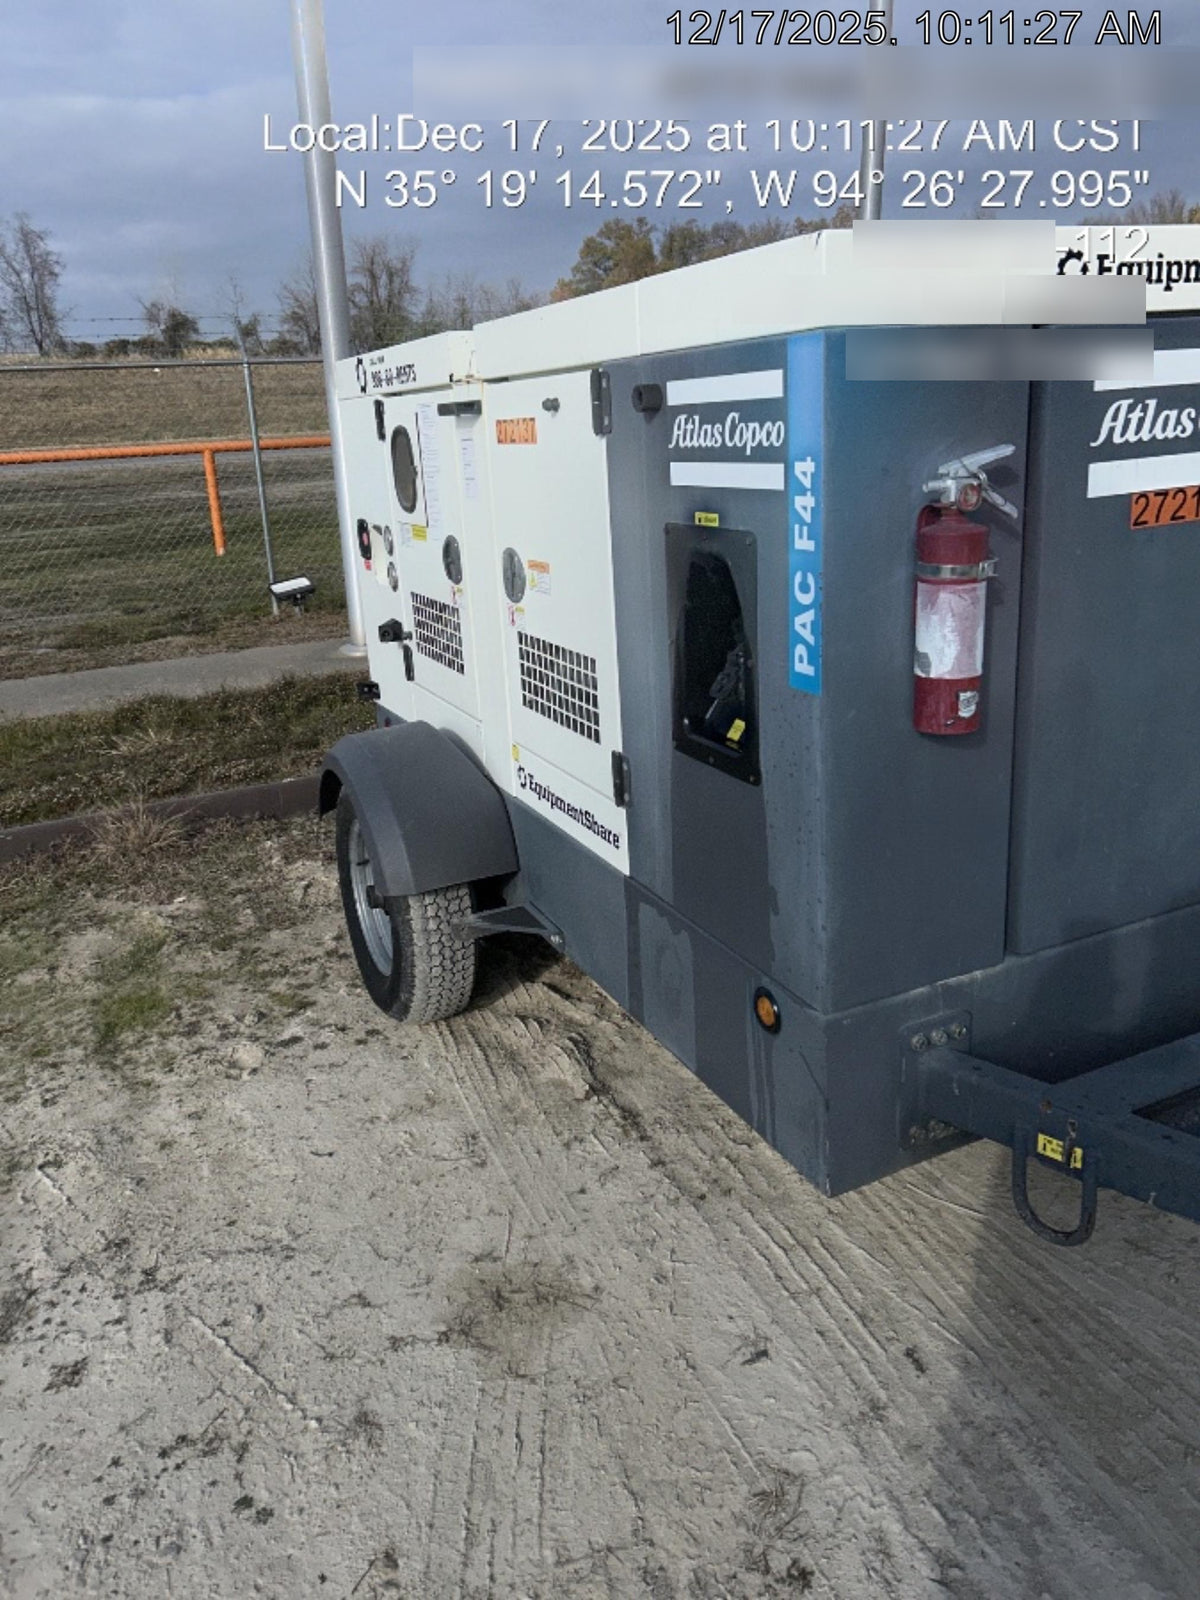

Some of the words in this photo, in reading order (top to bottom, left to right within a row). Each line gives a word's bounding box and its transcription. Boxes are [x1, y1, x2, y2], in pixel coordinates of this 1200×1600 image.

[725, 411, 785, 456] Copco
[1089, 399, 1196, 447] Atlas
[794, 456, 816, 552] F44
[1131, 486, 1200, 527] 2721
[794, 570, 816, 677] PAC
[527, 772, 621, 851] EquipmentShare
